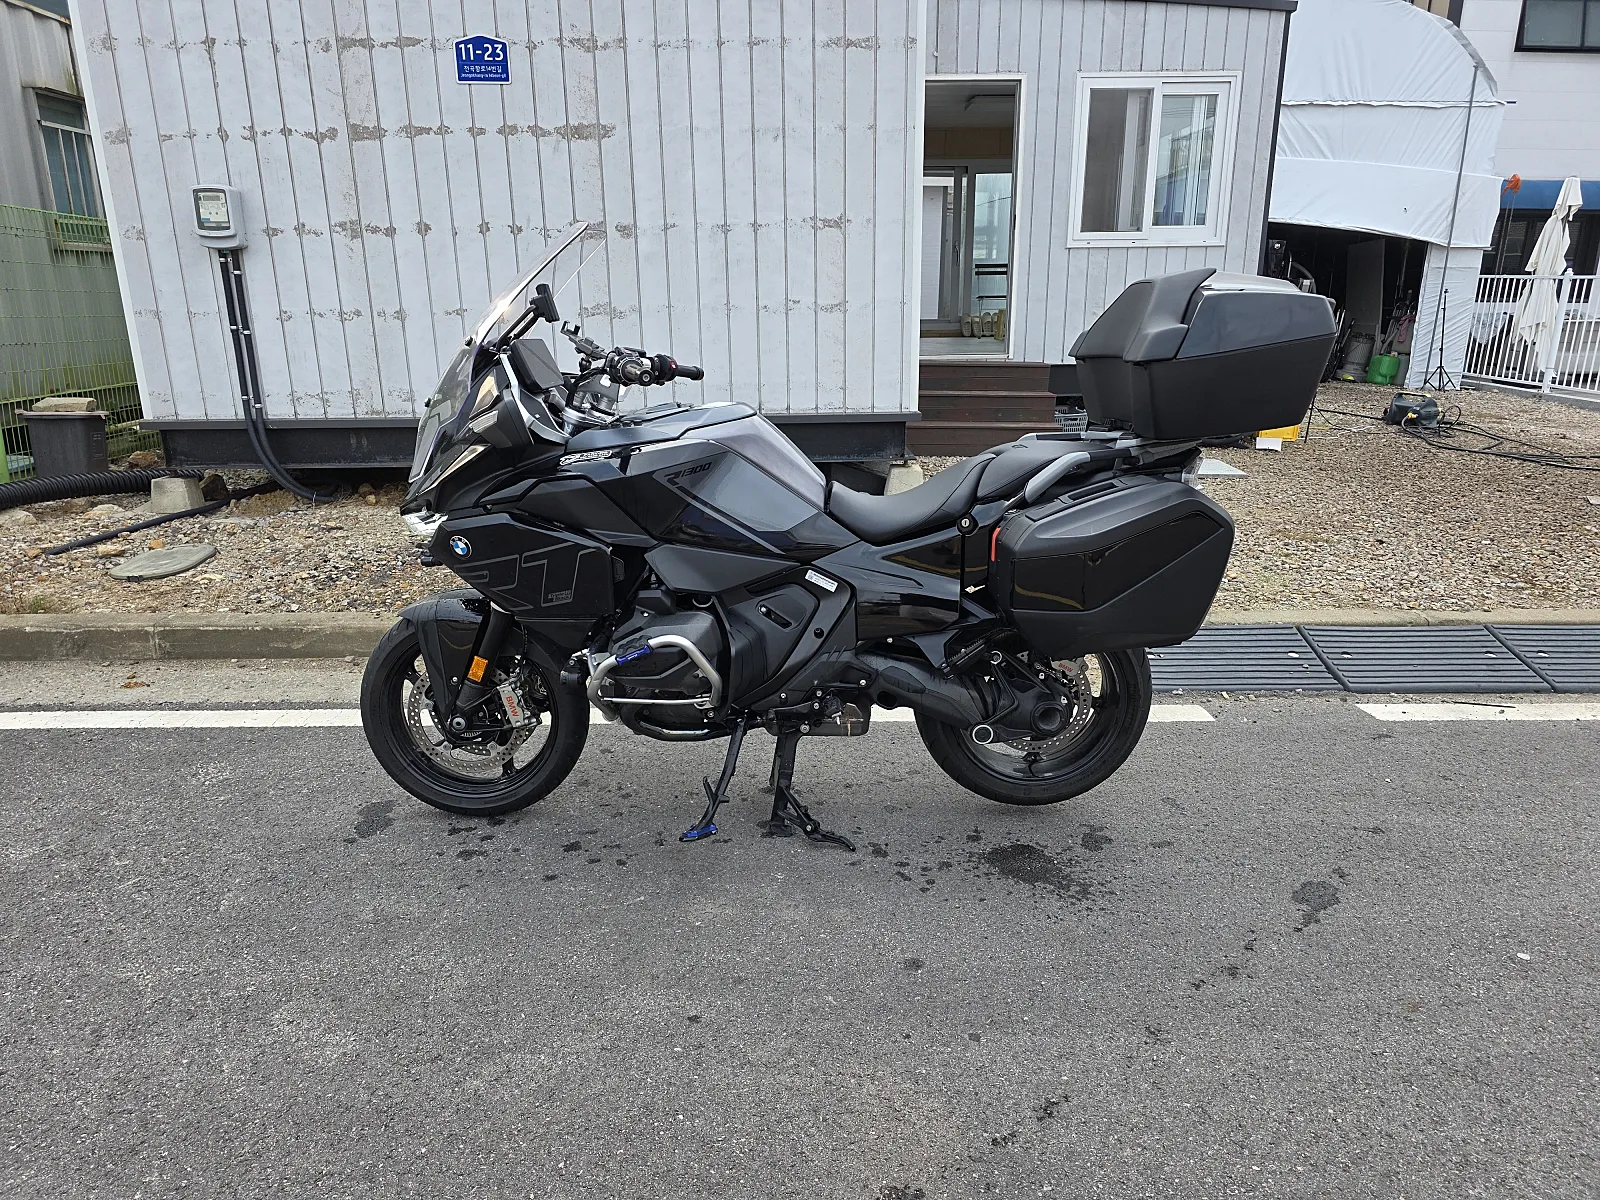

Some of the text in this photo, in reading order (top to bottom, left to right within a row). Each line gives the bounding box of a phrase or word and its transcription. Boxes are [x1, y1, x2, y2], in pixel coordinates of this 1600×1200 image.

[458, 43, 504, 61] 11-23
[463, 65, 502, 73] 전곡항로14번길
[1058, 663, 1073, 672] BMW
[505, 695, 520, 717] BMW
